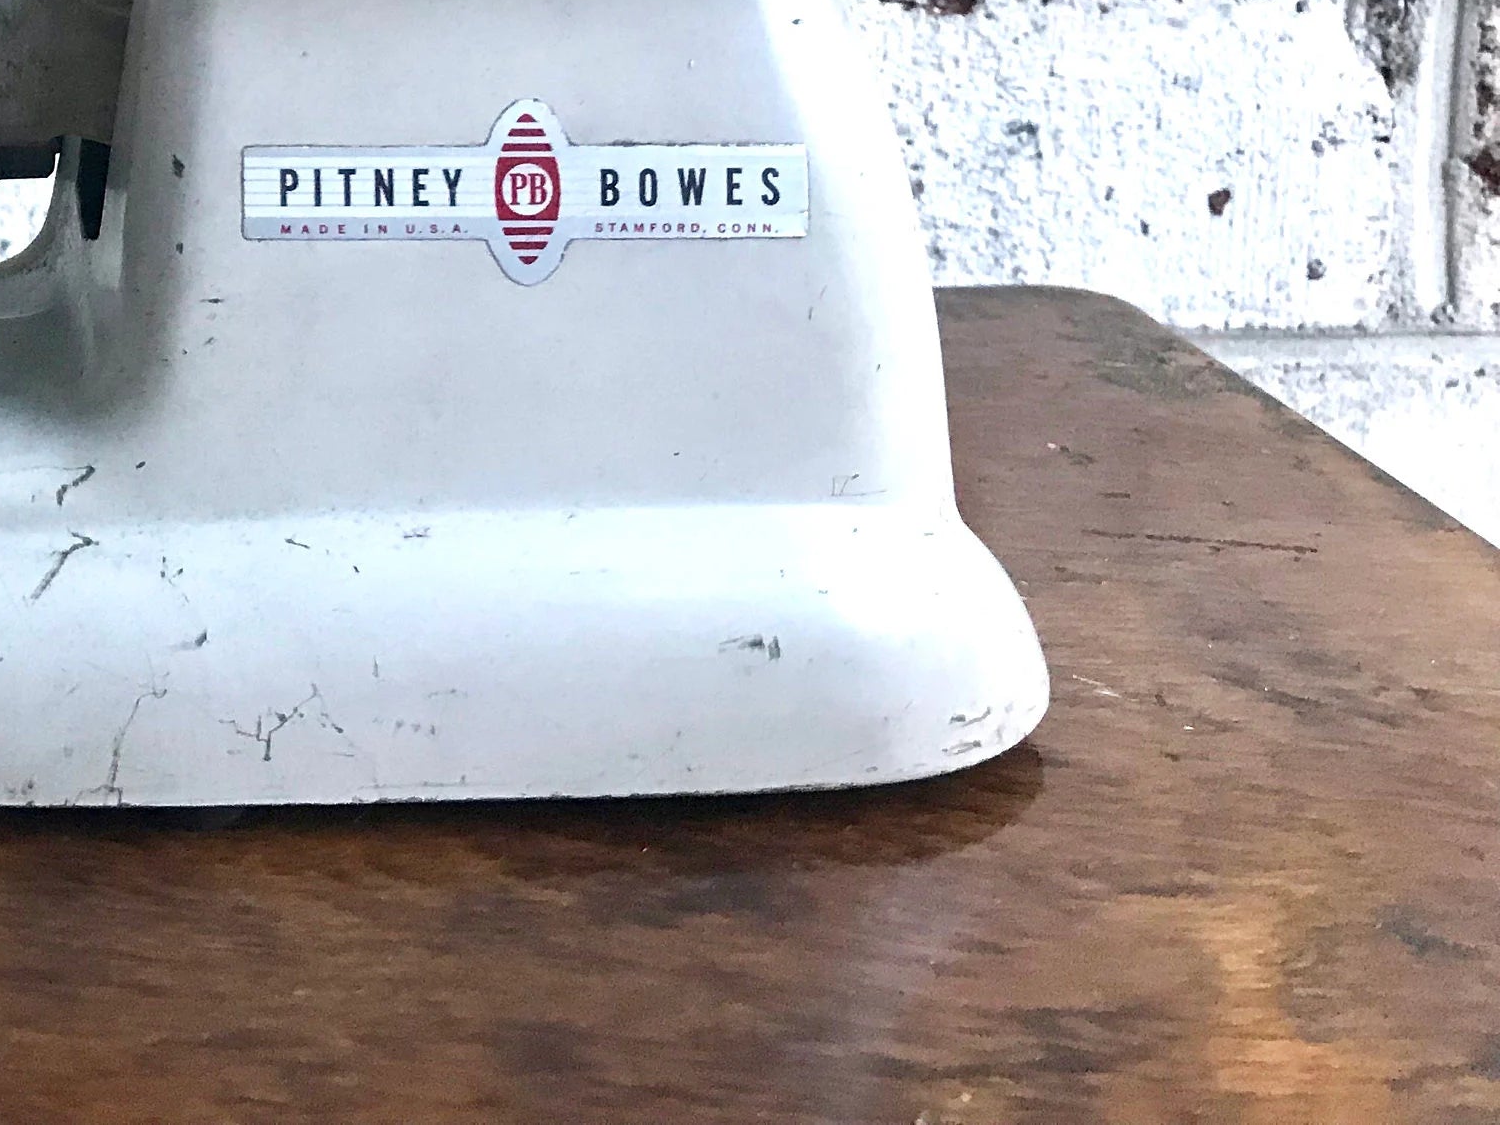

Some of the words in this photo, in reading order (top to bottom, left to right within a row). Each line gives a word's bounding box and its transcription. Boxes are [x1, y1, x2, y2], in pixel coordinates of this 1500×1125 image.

[279, 168, 462, 207] PITNEY
[508, 172, 548, 206] PB
[599, 167, 781, 207] BOWES
[280, 224, 346, 234] MADE
[364, 224, 388, 234] IN
[405, 224, 469, 234] U.S.A.
[717, 222, 779, 234] CONN.
